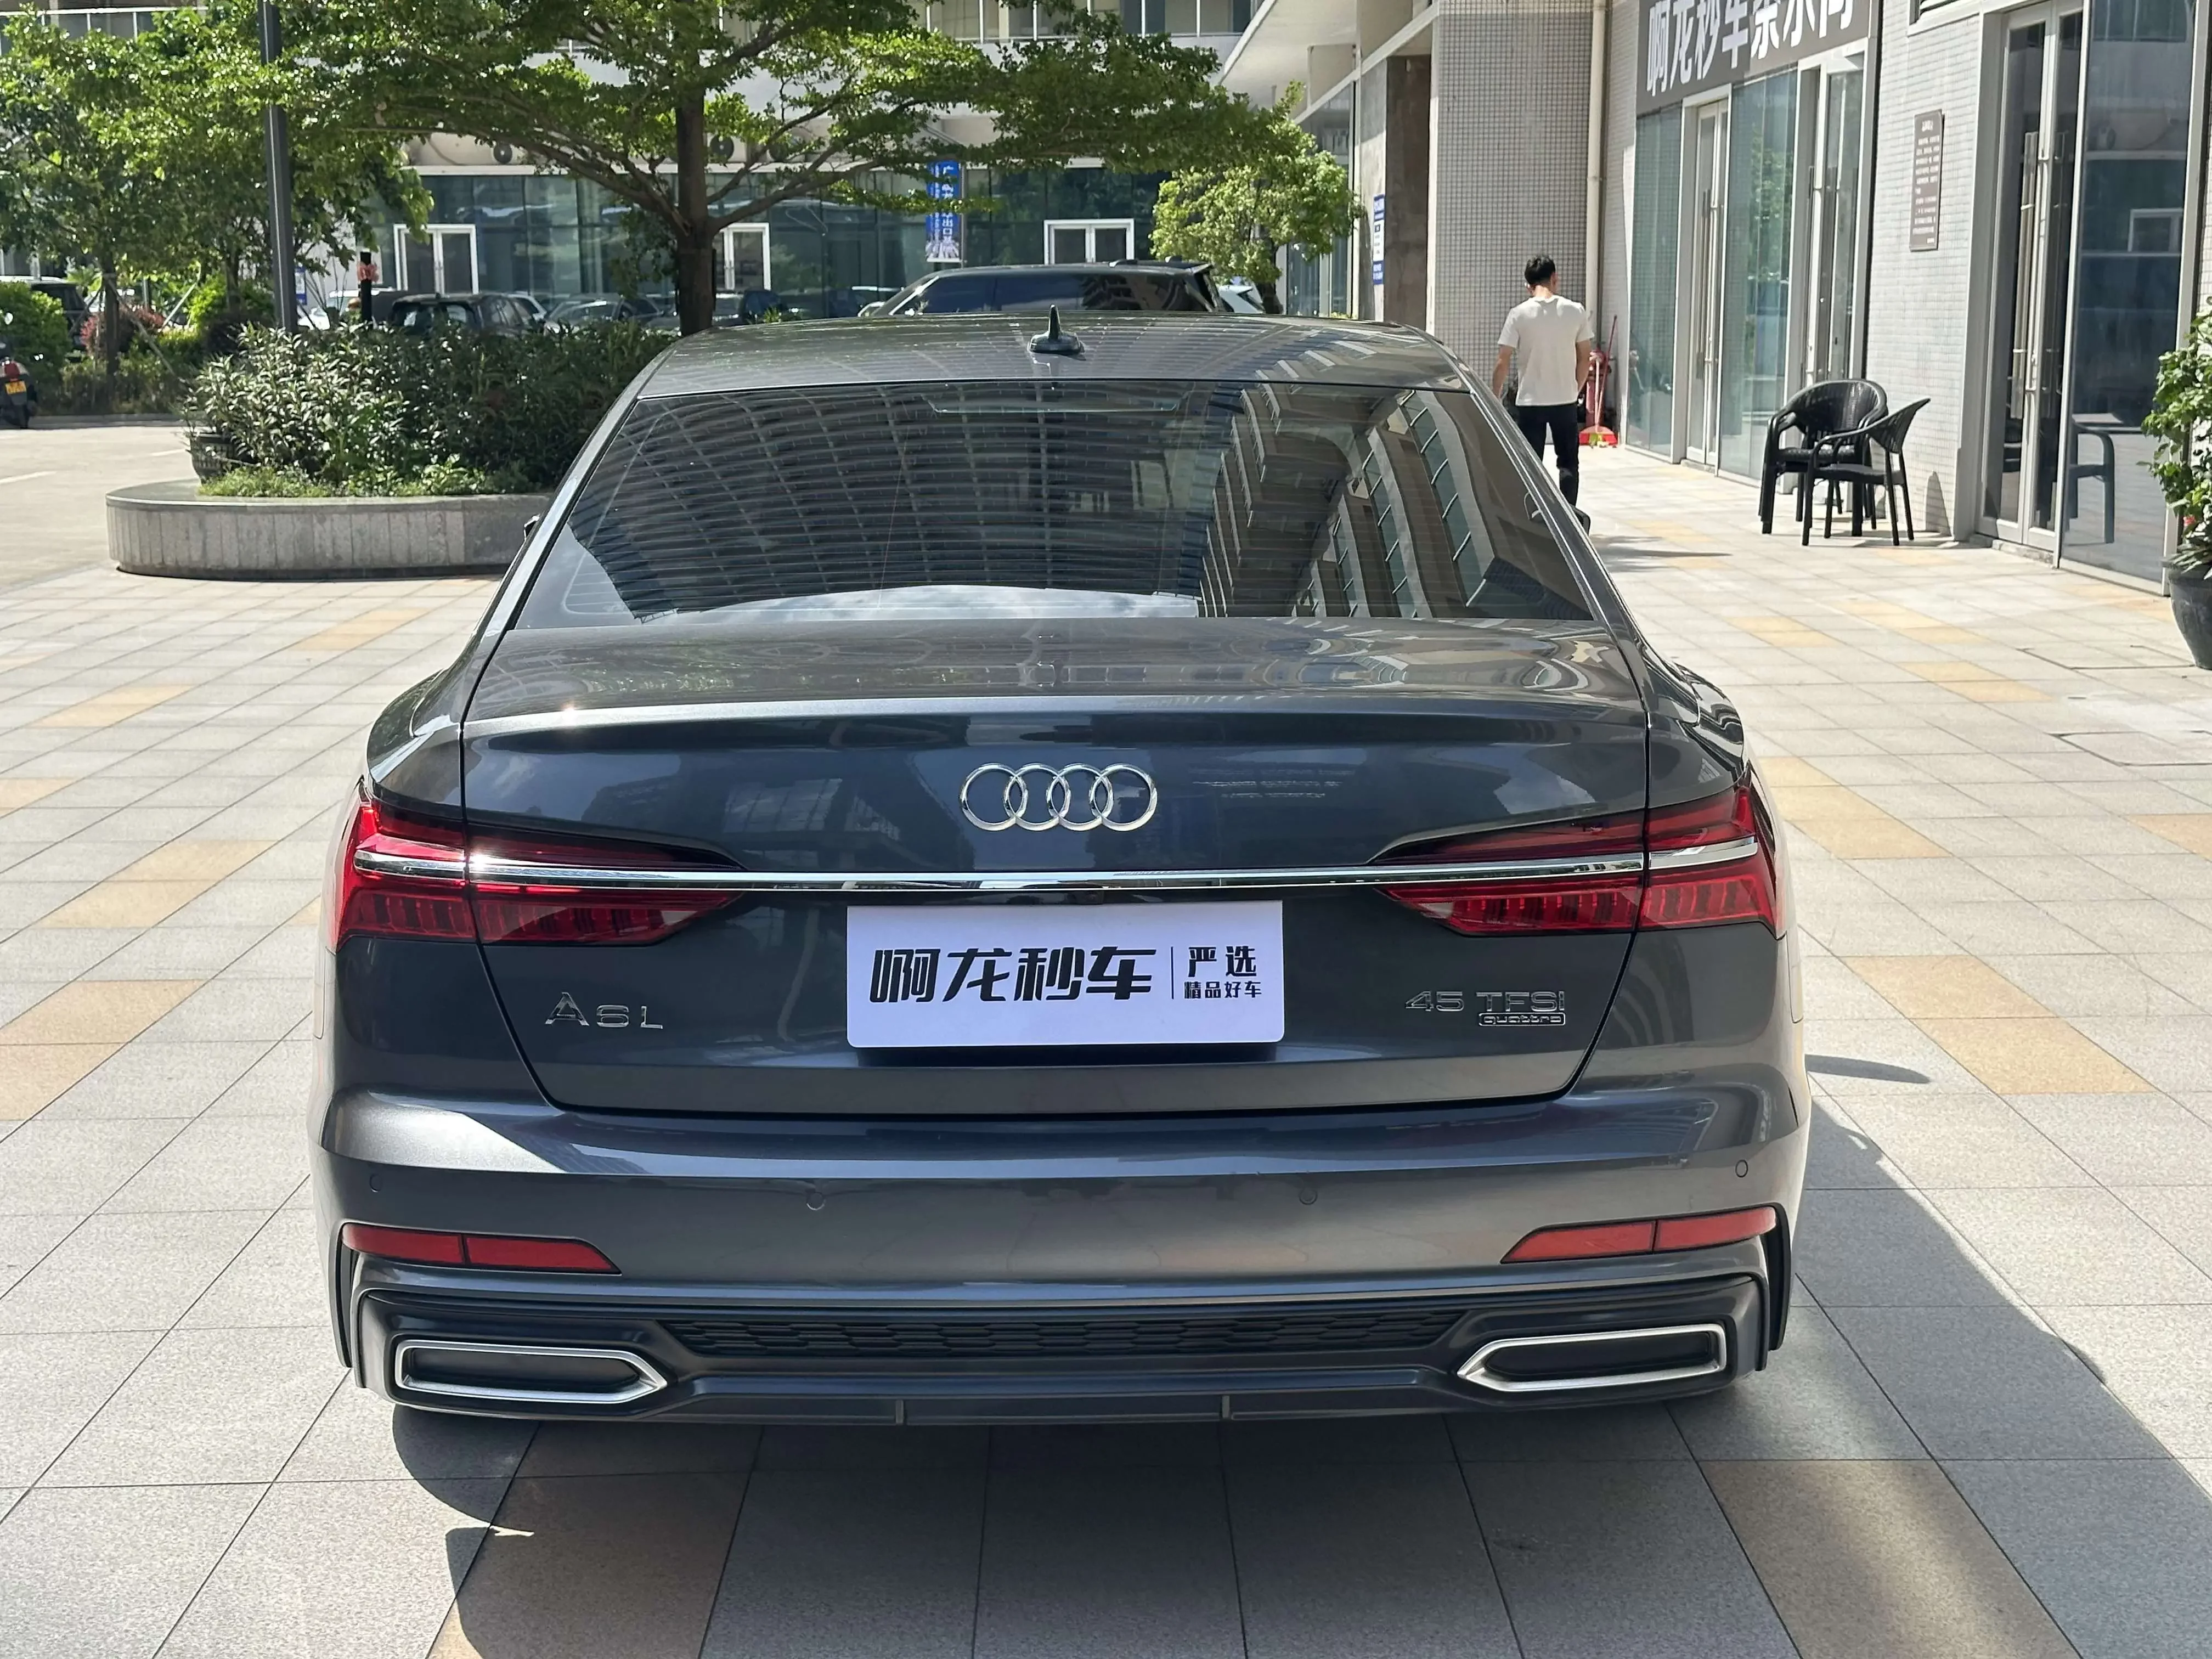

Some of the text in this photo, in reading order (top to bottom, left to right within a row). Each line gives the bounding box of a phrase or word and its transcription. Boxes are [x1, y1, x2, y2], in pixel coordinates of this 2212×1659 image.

[870, 946, 1157, 1003] 啊龙秒车
[1188, 945, 1257, 977] 严选
[1184, 980, 1262, 999] 精品好车
[1406, 990, 1565, 1012] 45 TFSI
[544, 991, 663, 1030] A6L
[1483, 1015, 1562, 1025] quattro
